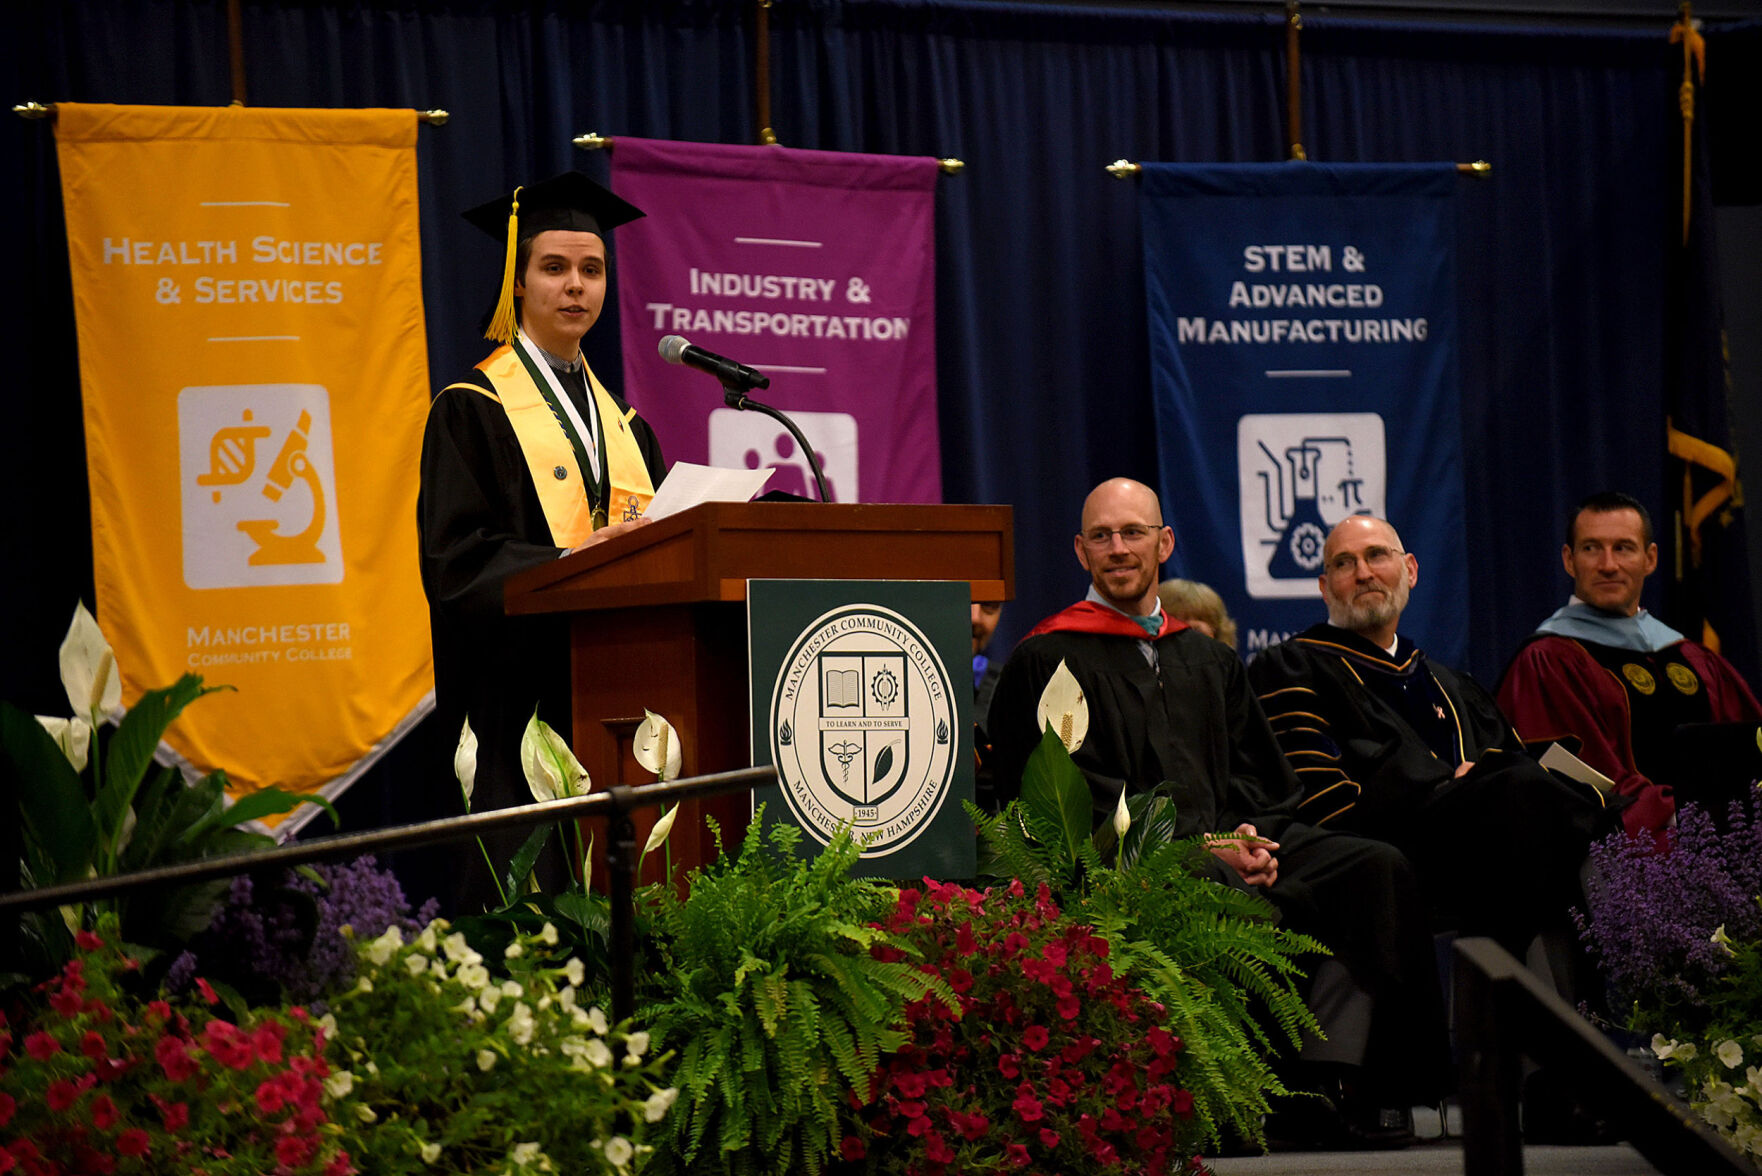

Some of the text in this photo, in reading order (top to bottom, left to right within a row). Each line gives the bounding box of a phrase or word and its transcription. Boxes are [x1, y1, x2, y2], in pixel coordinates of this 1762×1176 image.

[103, 236, 383, 266] HEALTH SCIENCE
[1244, 245, 1365, 272] STEM &
[155, 276, 343, 305] & SERVICES
[690, 268, 871, 303] INDUSTRY &
[1229, 281, 1383, 308] ADVANCED
[646, 303, 910, 340] TRANSPORTATION
[1177, 317, 1428, 344] MANUFACTURING
[187, 622, 350, 648] MANCHESTER
[286, 647, 352, 662] COLLEGE
[785, 617, 943, 701] MANCHESTER COMMUNITY COLLEGE
[886, 779, 938, 837] HAMPSHIRE
